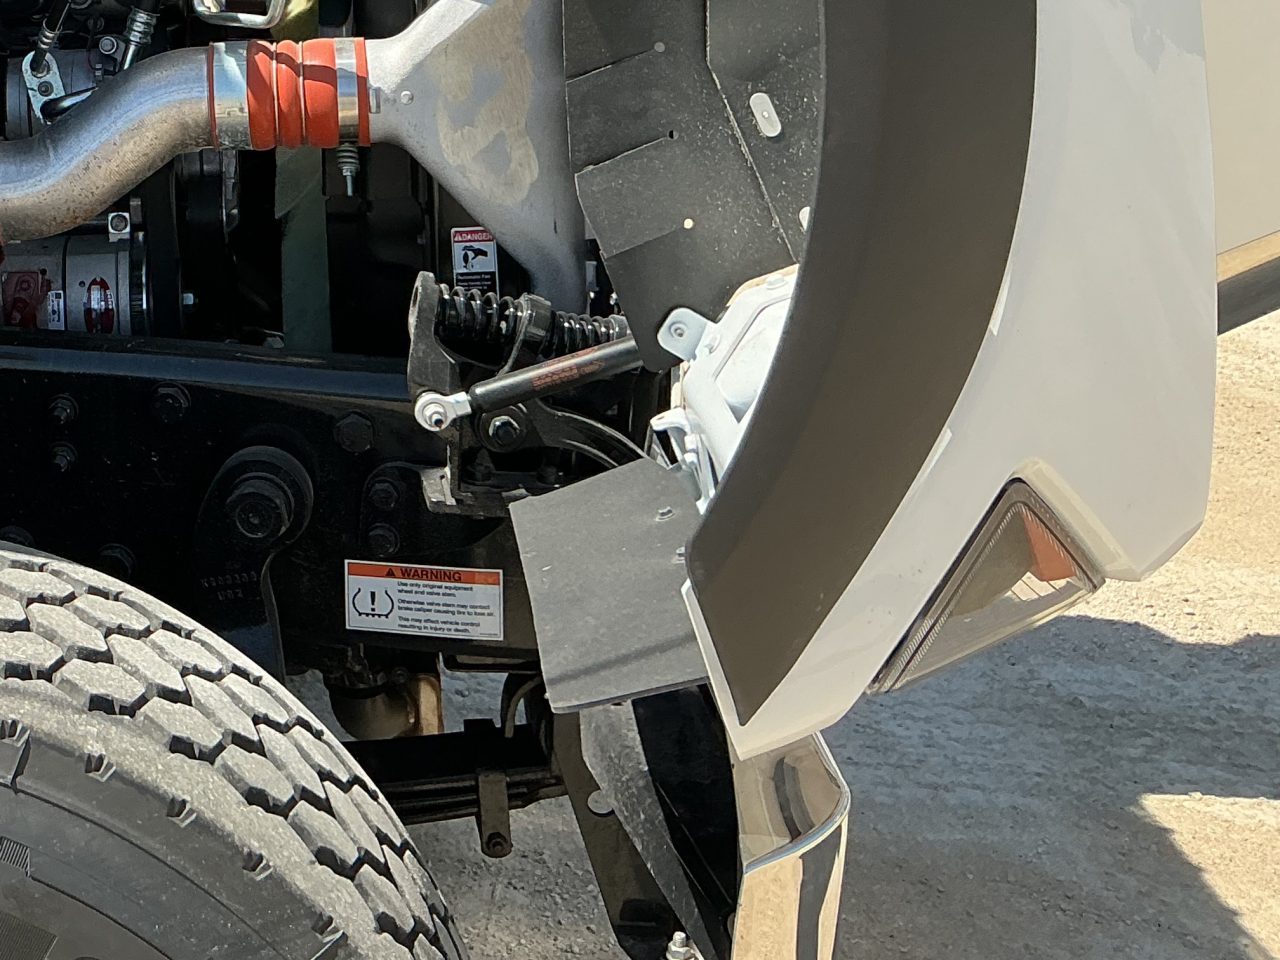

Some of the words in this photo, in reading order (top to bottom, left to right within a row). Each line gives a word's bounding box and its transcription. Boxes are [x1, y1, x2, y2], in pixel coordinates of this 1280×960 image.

[400, 567, 462, 583] WARNING
[422, 582, 443, 590] original
[397, 598, 425, 606] Otherwise
[433, 608, 456, 616] causing
[397, 623, 422, 631] resulting
